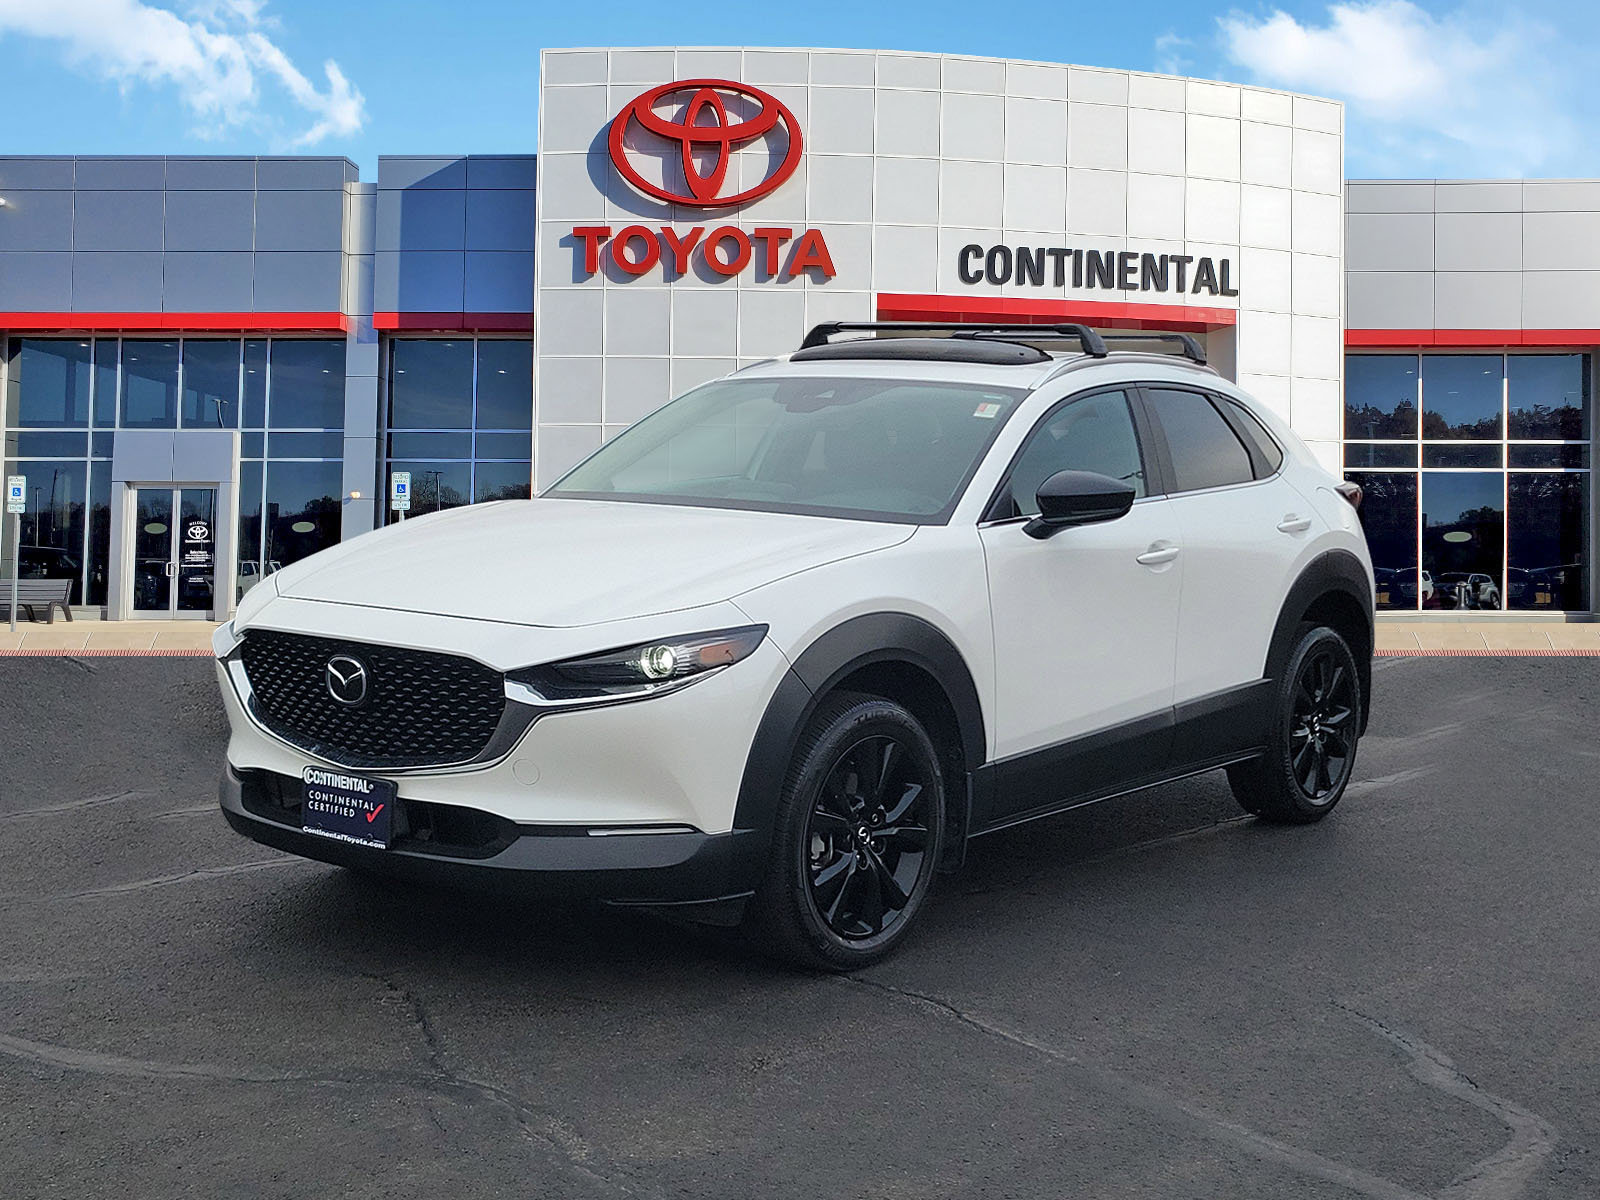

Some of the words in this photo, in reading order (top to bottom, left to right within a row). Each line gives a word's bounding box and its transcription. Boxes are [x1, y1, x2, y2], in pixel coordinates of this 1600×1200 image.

[572, 225, 837, 277] TOYOTA
[958, 244, 1239, 297] CONTINENTAL
[308, 790, 374, 811] CONTINENTAL
[308, 801, 355, 817] CERTIFIED
[303, 826, 386, 849] ContinentalToyota.com
